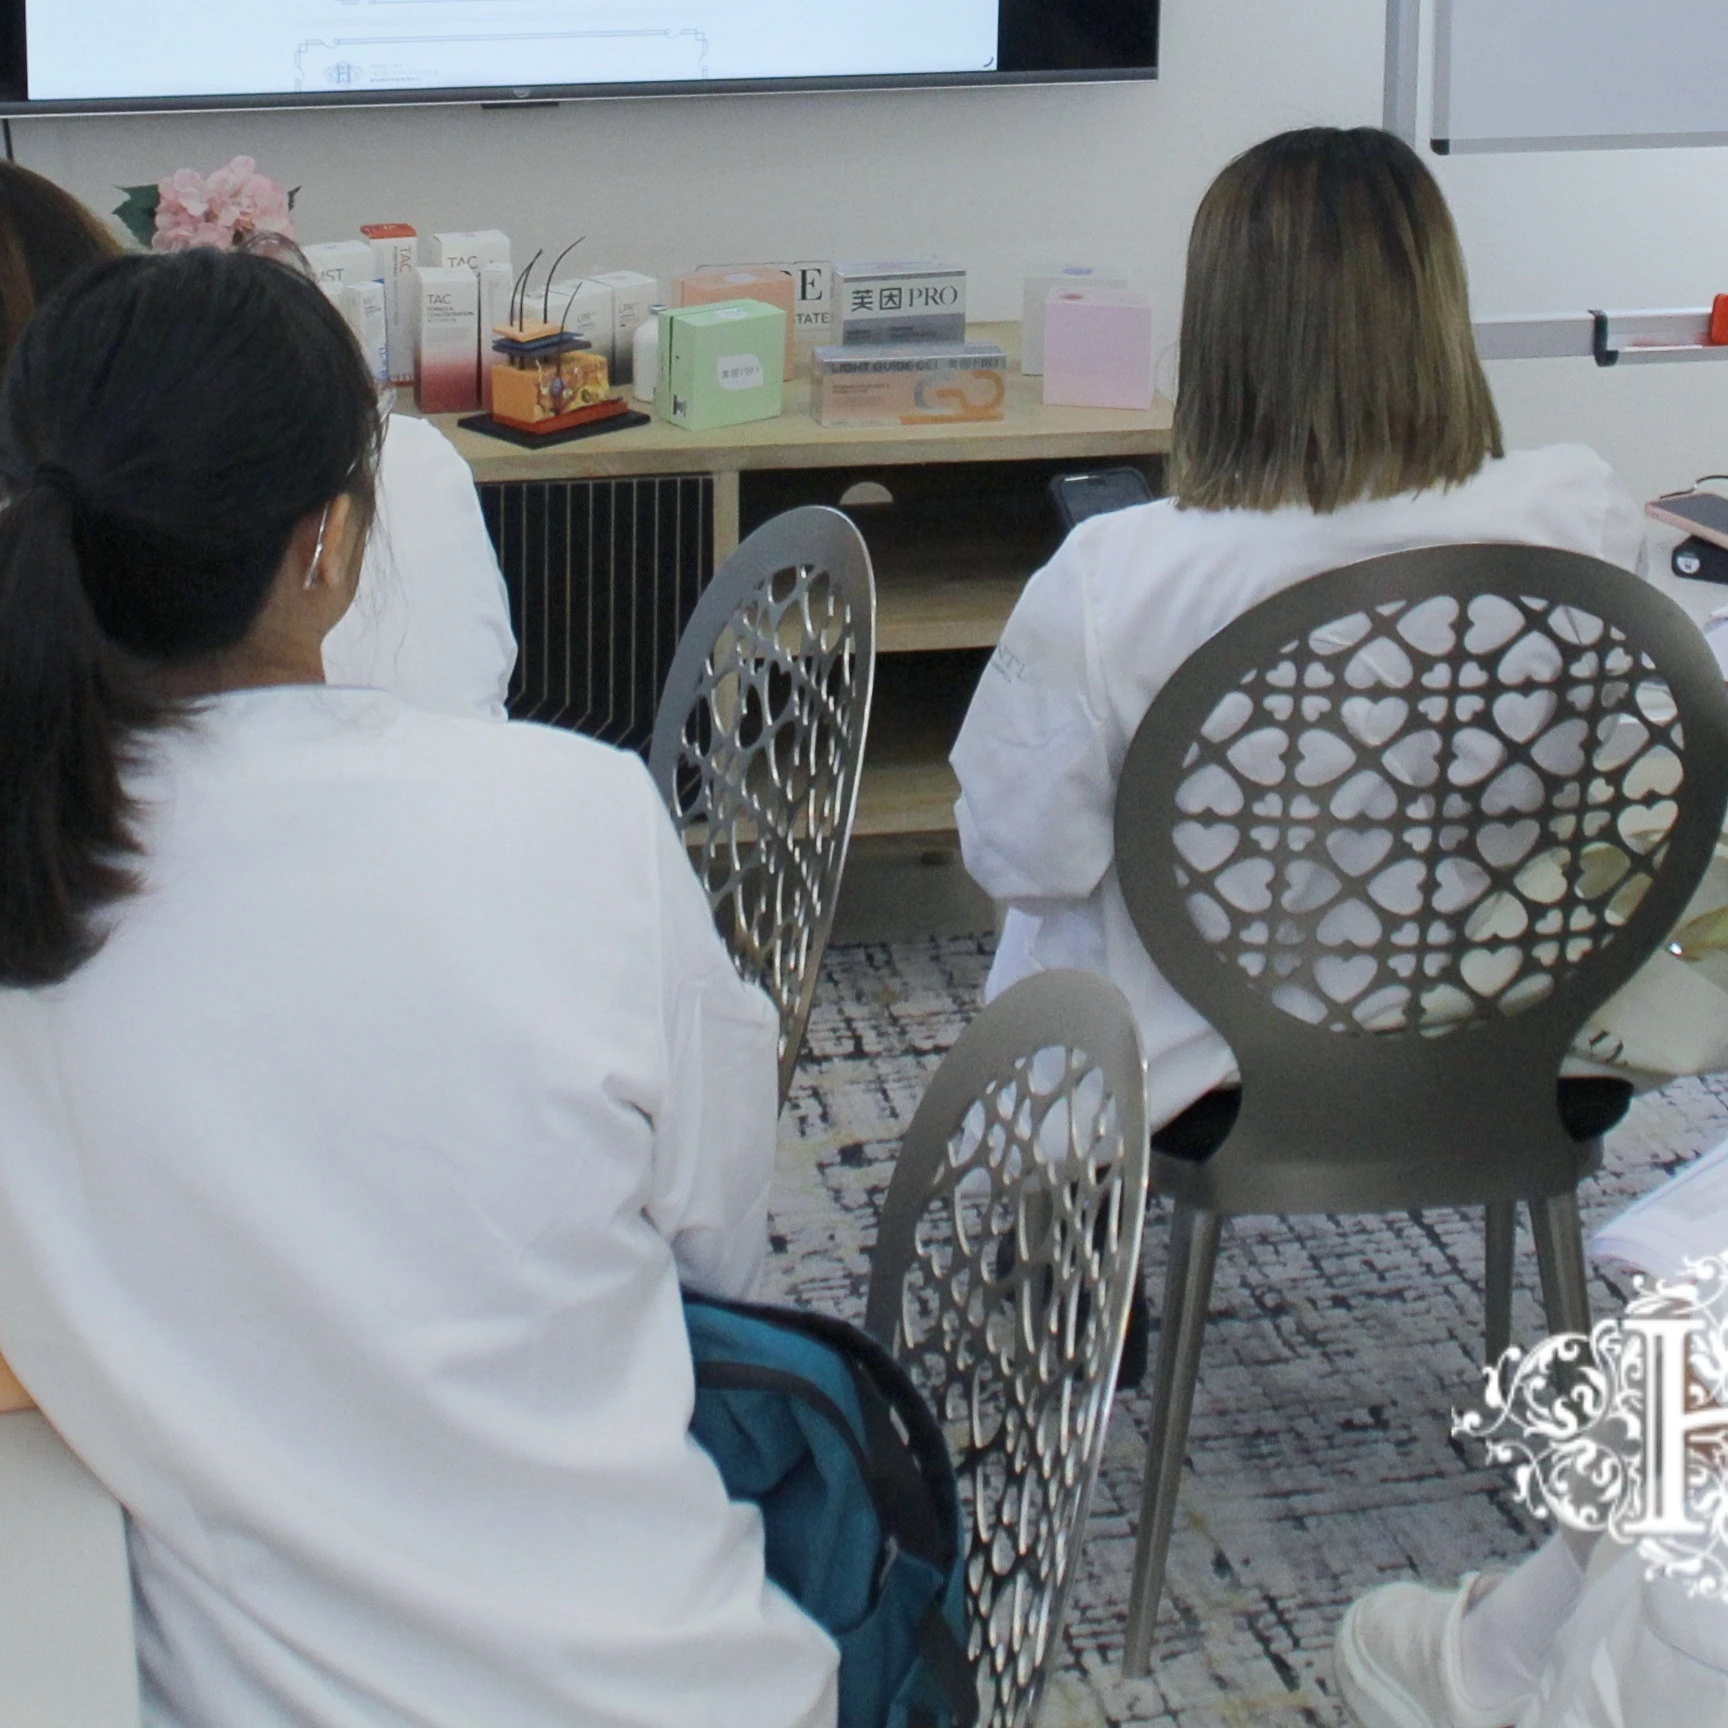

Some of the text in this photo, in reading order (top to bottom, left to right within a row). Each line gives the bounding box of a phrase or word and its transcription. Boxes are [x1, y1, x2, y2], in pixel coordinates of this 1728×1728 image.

[321, 268, 345, 282] ST
[426, 293, 452, 305] TAC
[908, 285, 958, 308] PRO
[794, 312, 829, 324] TATE
[872, 361, 914, 372] GUIDE
